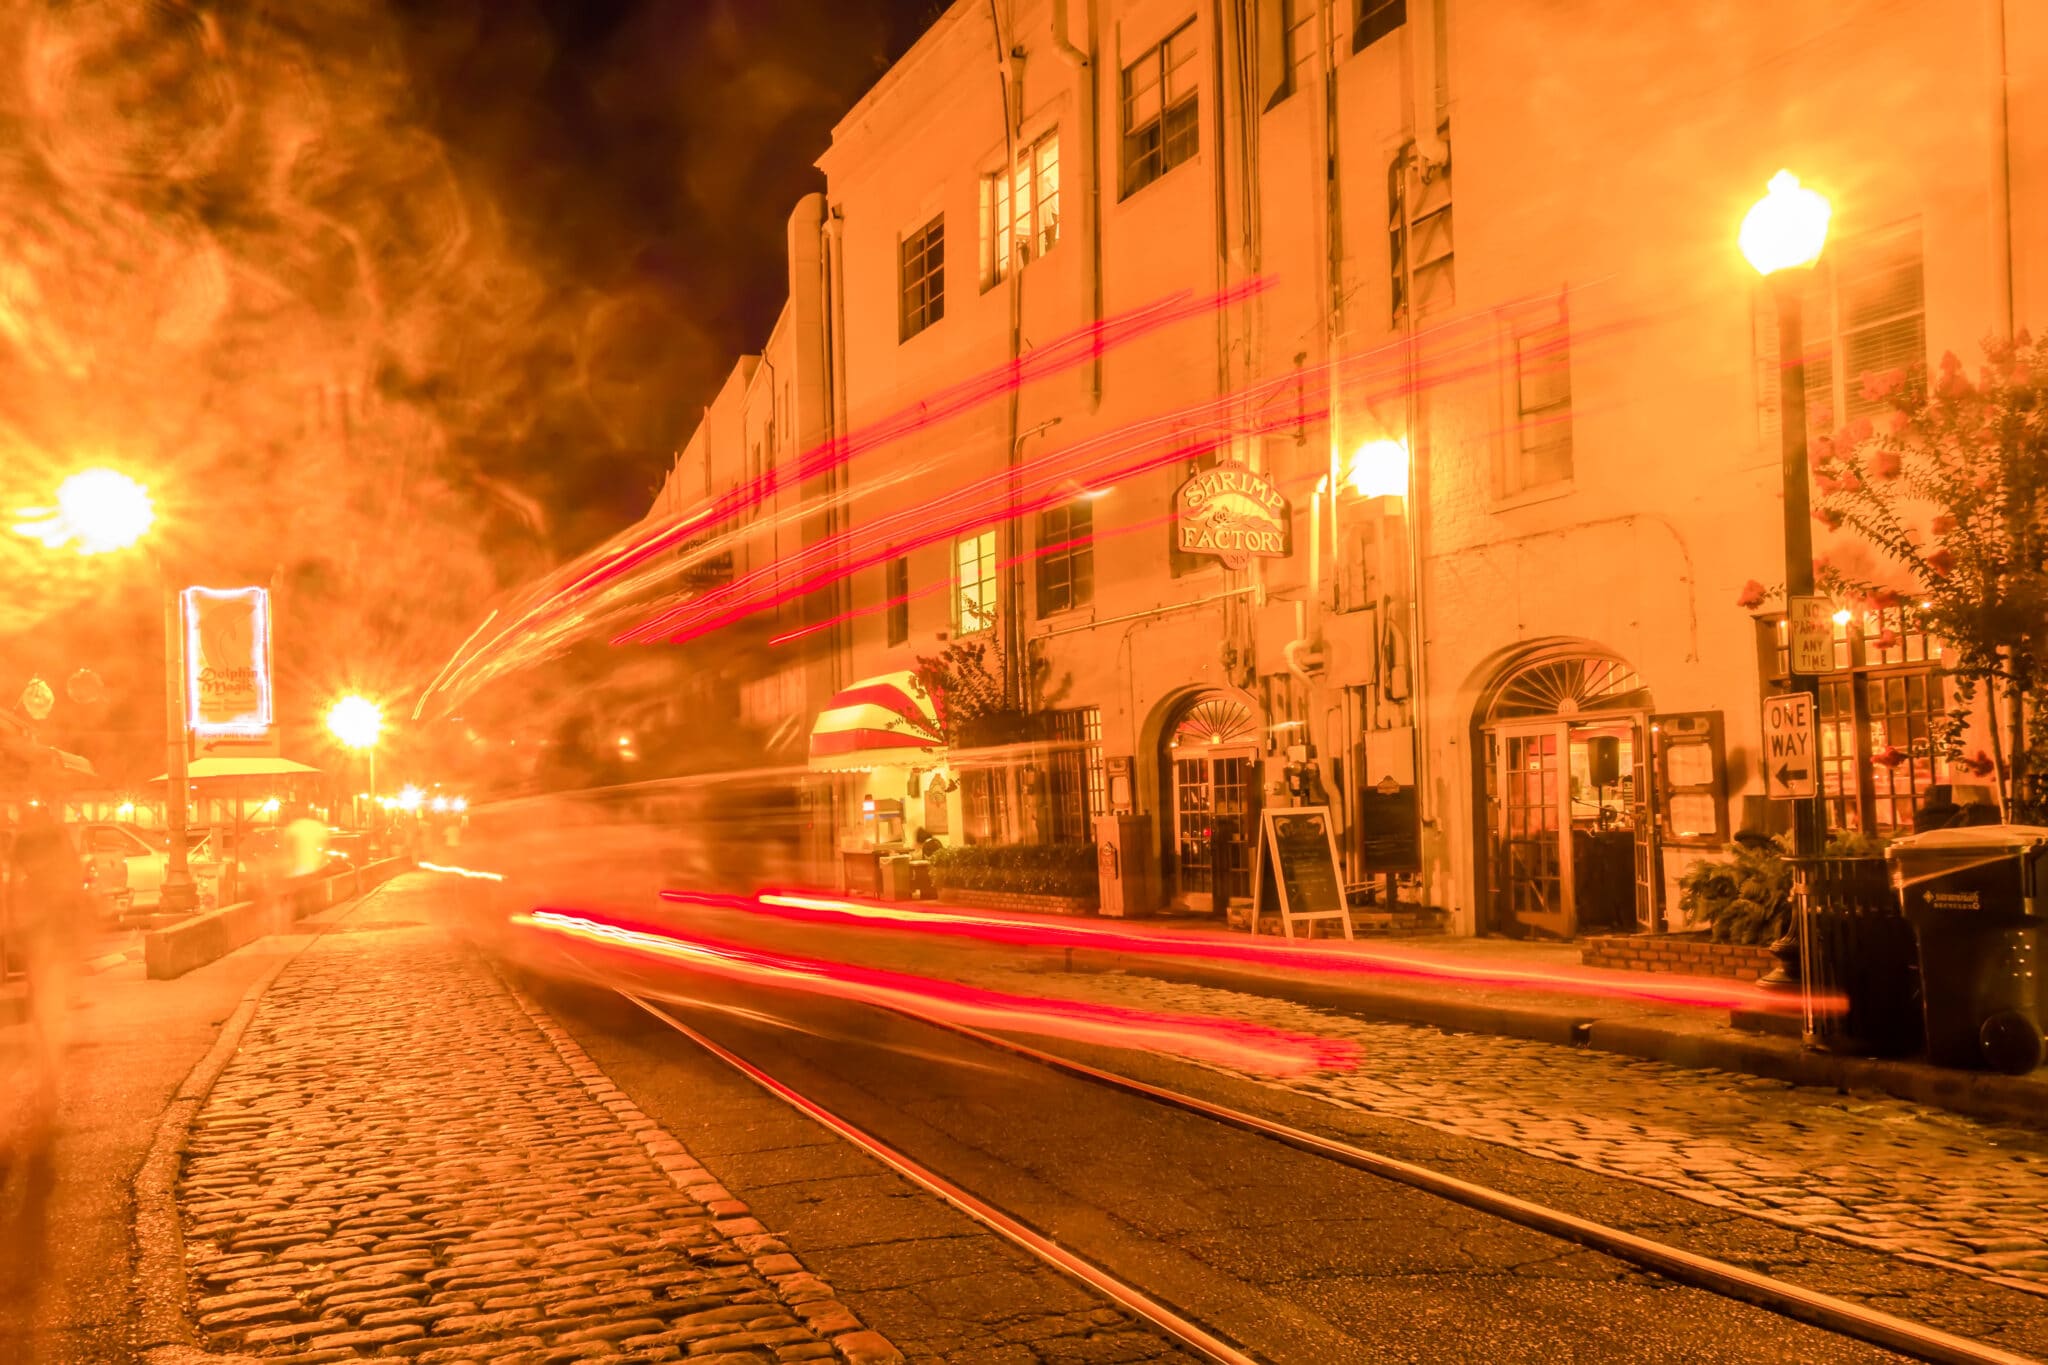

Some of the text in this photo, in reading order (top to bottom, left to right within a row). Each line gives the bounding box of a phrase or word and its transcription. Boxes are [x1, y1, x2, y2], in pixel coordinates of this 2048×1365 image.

[1184, 471, 1285, 508] SHRIMP
[1182, 527, 1284, 552] FACTORY
[1803, 603, 1819, 618] NO
[1803, 640, 1823, 652] ANY
[1801, 654, 1827, 668] TIME
[197, 666, 258, 682] Dolphin
[1771, 703, 1806, 729] ONE
[1771, 732, 1807, 757] WAY
